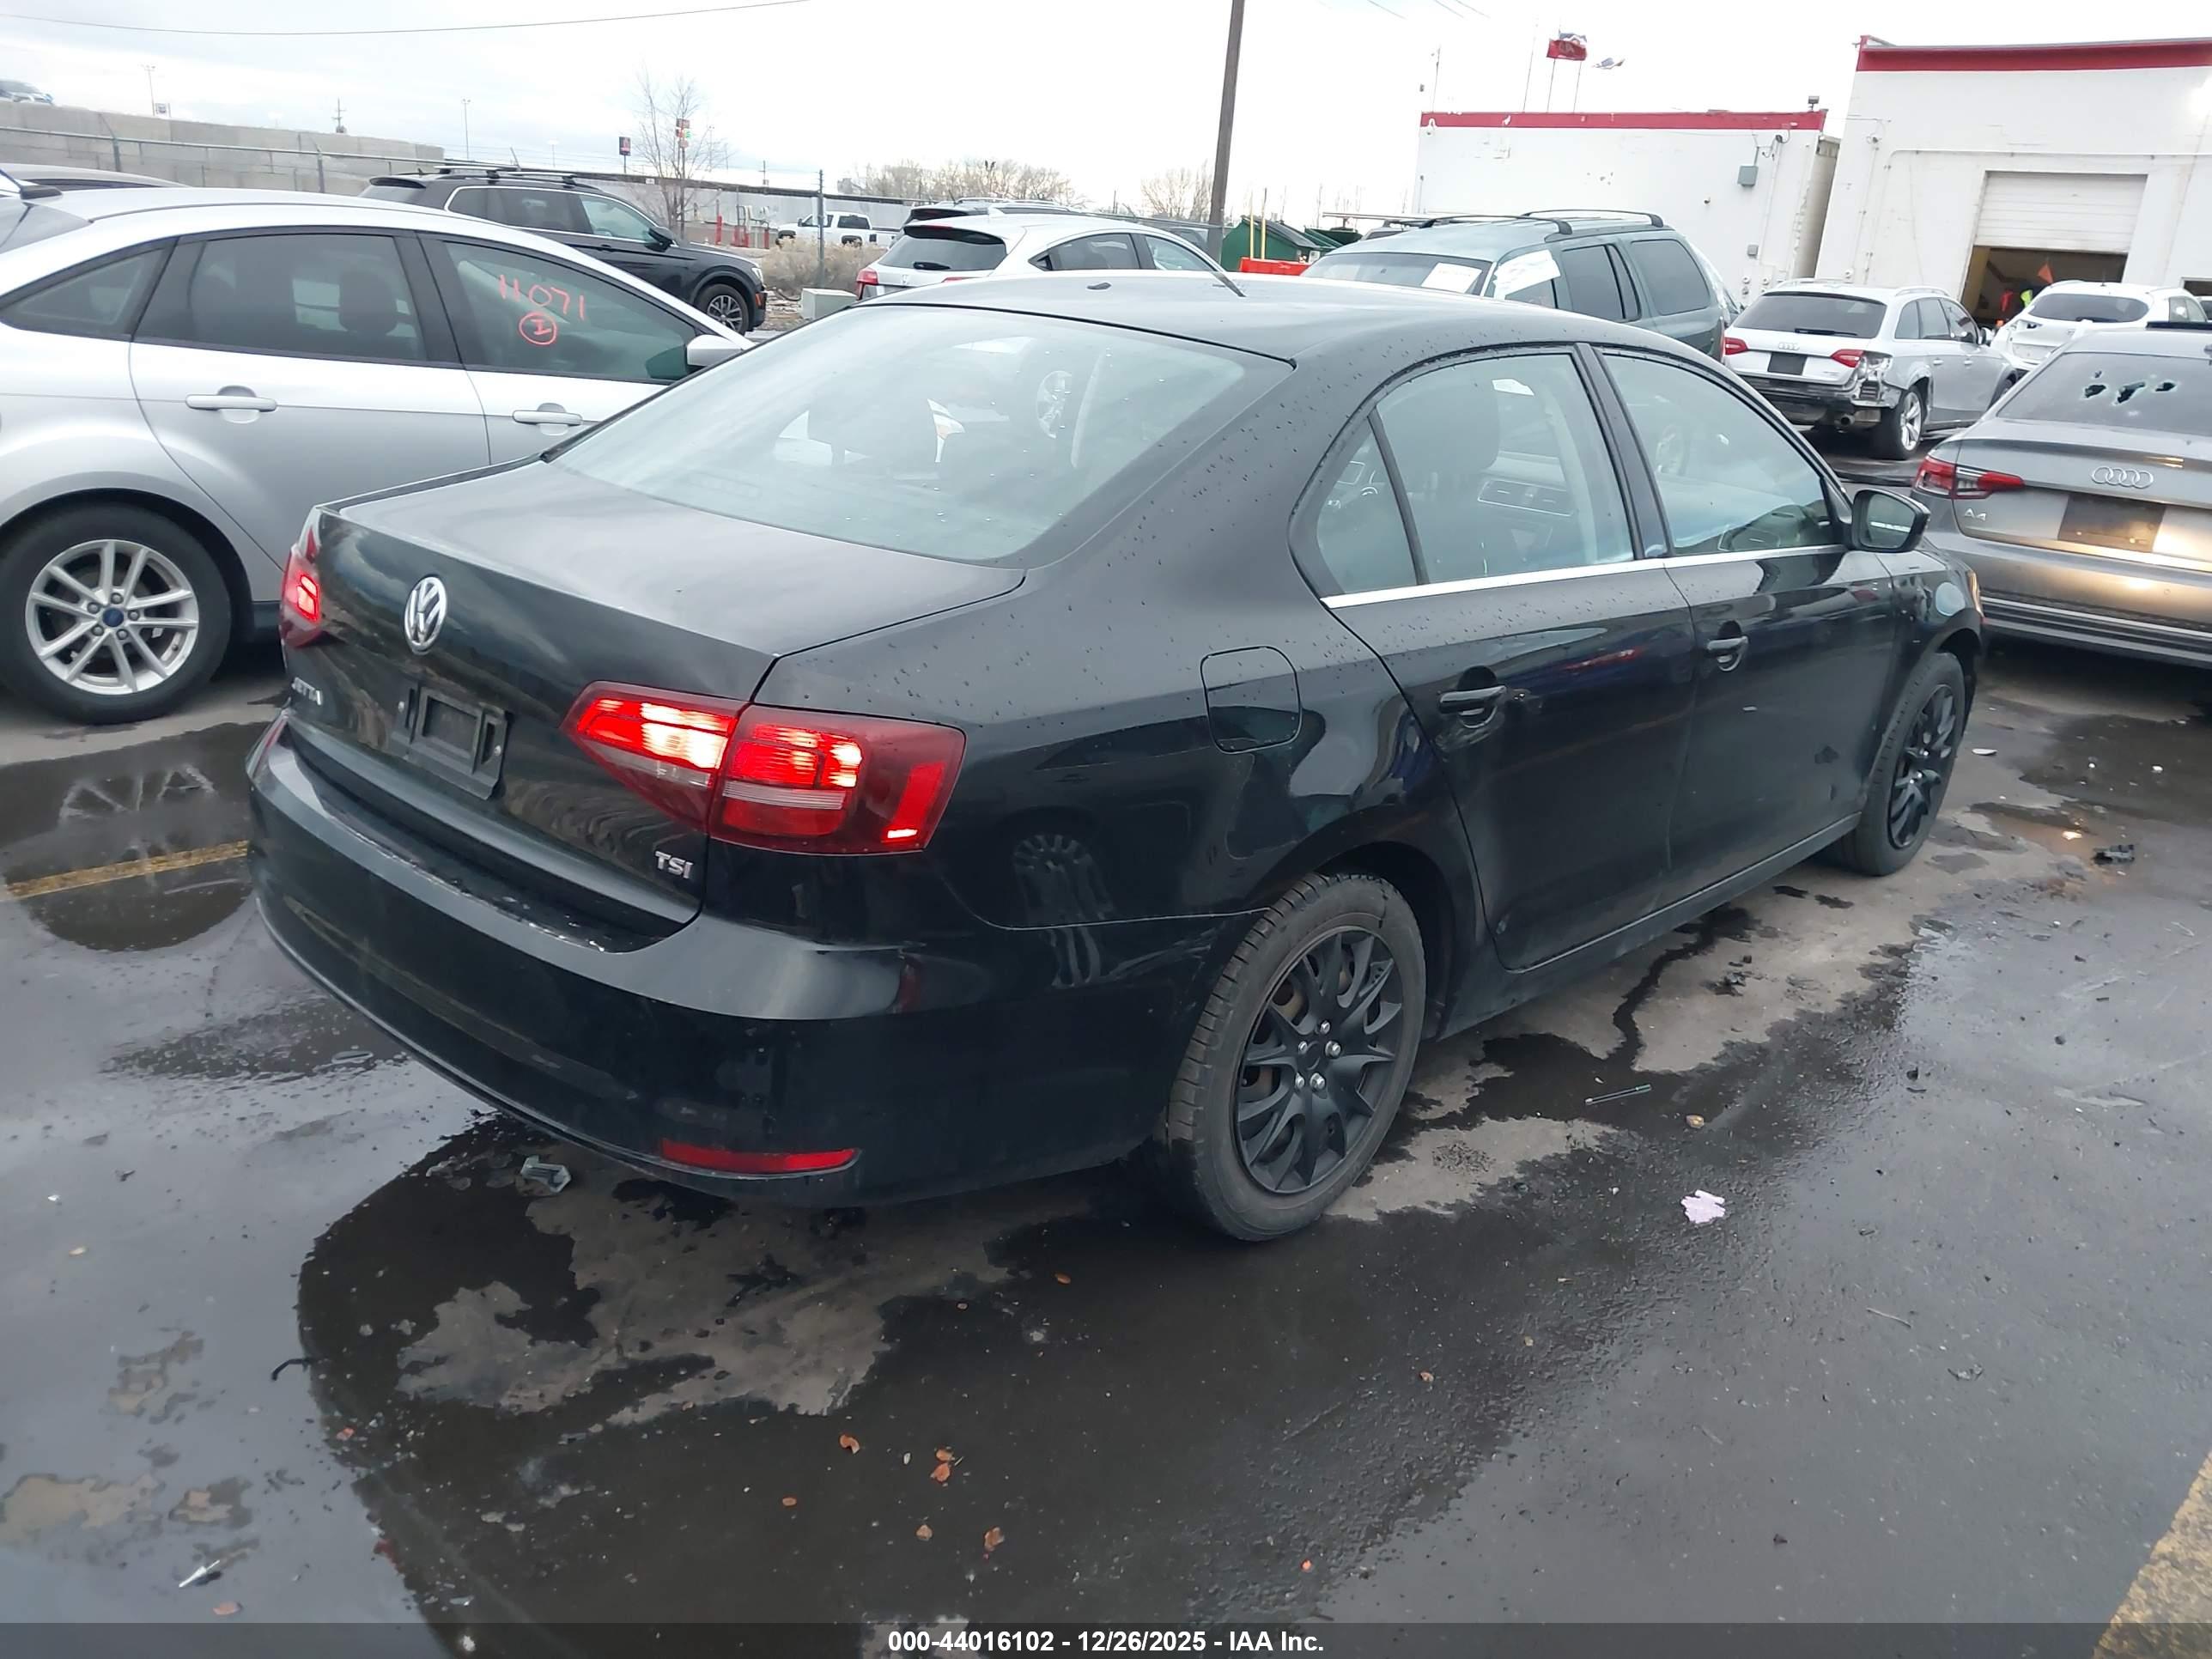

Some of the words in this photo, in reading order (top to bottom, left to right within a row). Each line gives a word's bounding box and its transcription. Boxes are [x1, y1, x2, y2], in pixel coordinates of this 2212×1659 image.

[500, 274, 585, 320] 11071
[1965, 507, 1986, 521] A4
[655, 850, 694, 878] TSI
